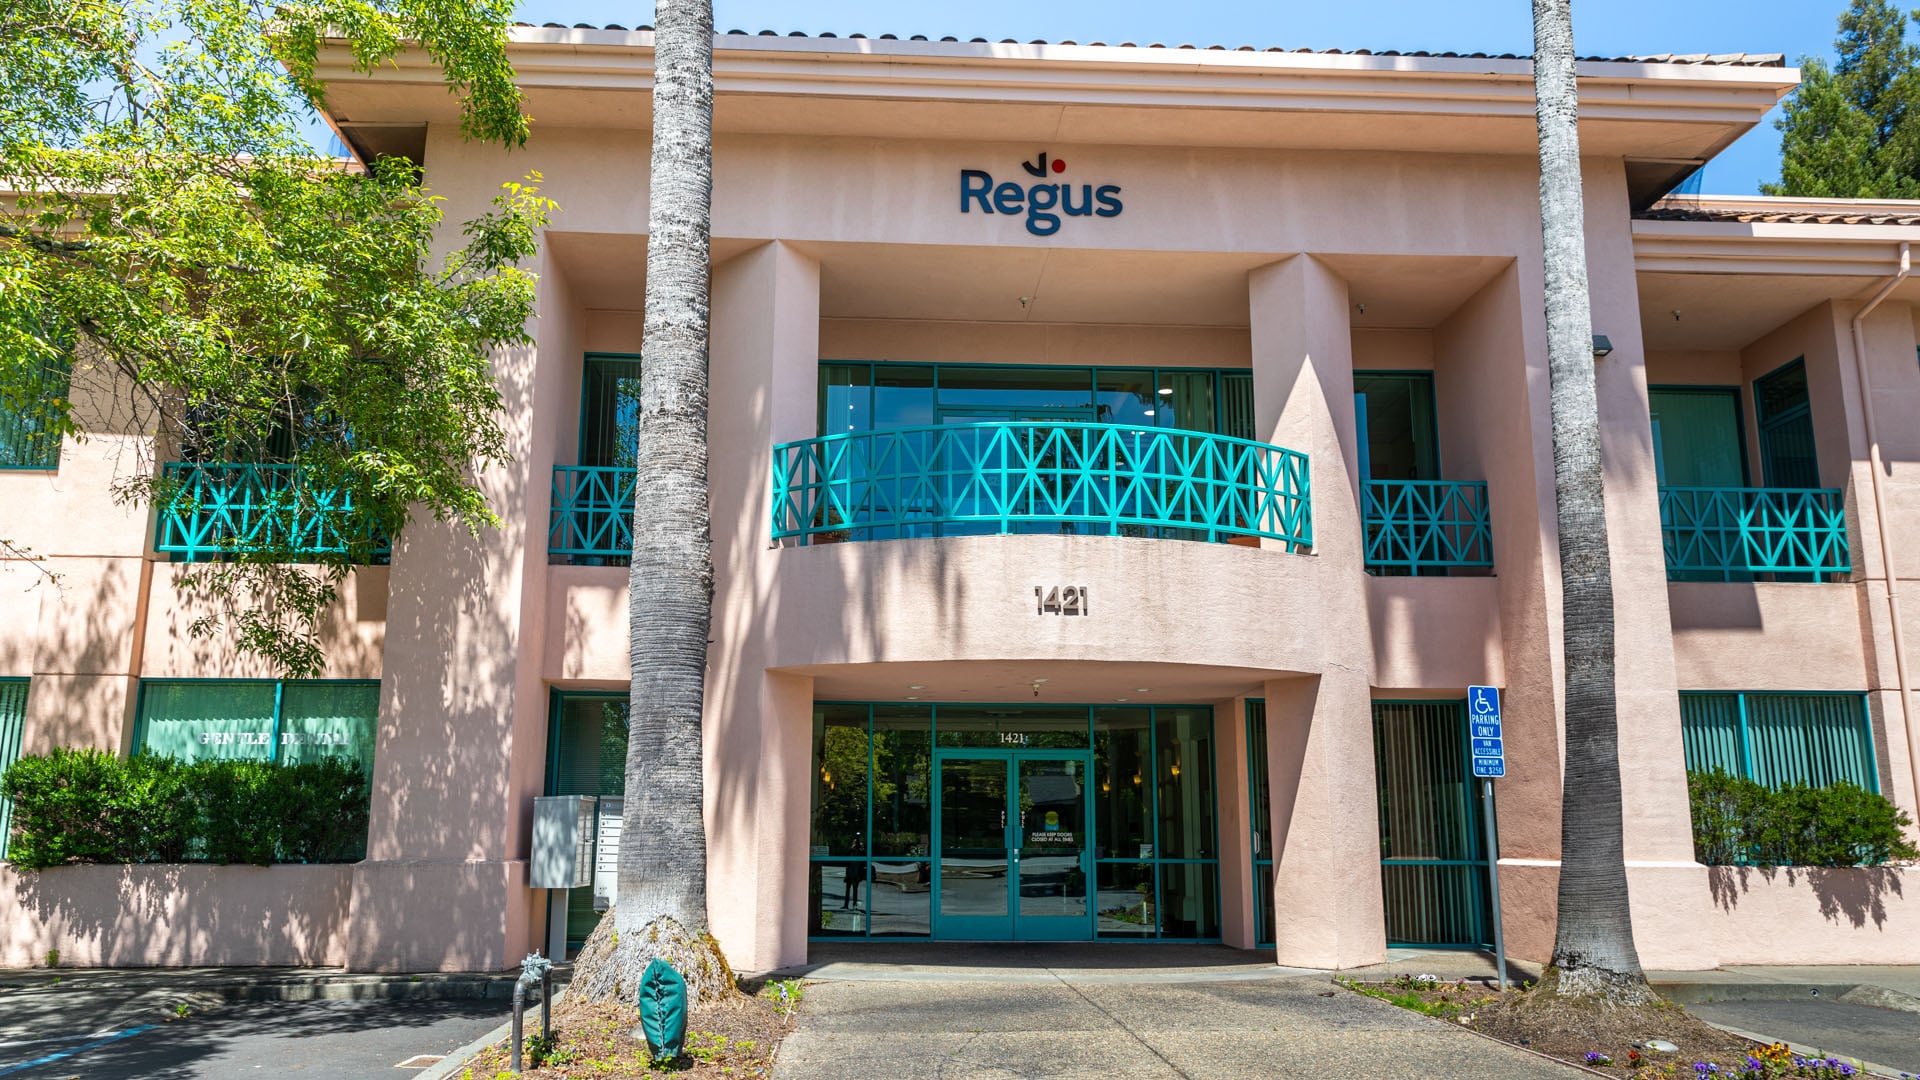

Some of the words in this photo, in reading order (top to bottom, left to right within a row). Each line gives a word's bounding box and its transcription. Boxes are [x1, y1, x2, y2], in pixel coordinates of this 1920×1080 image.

[960, 169, 1123, 236] Regus
[1035, 586, 1088, 616] 1421
[1472, 714, 1499, 726] PARKING
[1478, 726, 1494, 736] ONLY
[198, 732, 270, 745] GENTLE
[1000, 732, 1024, 744] 1421
[1475, 747, 1501, 756] ACCESSIBLE
